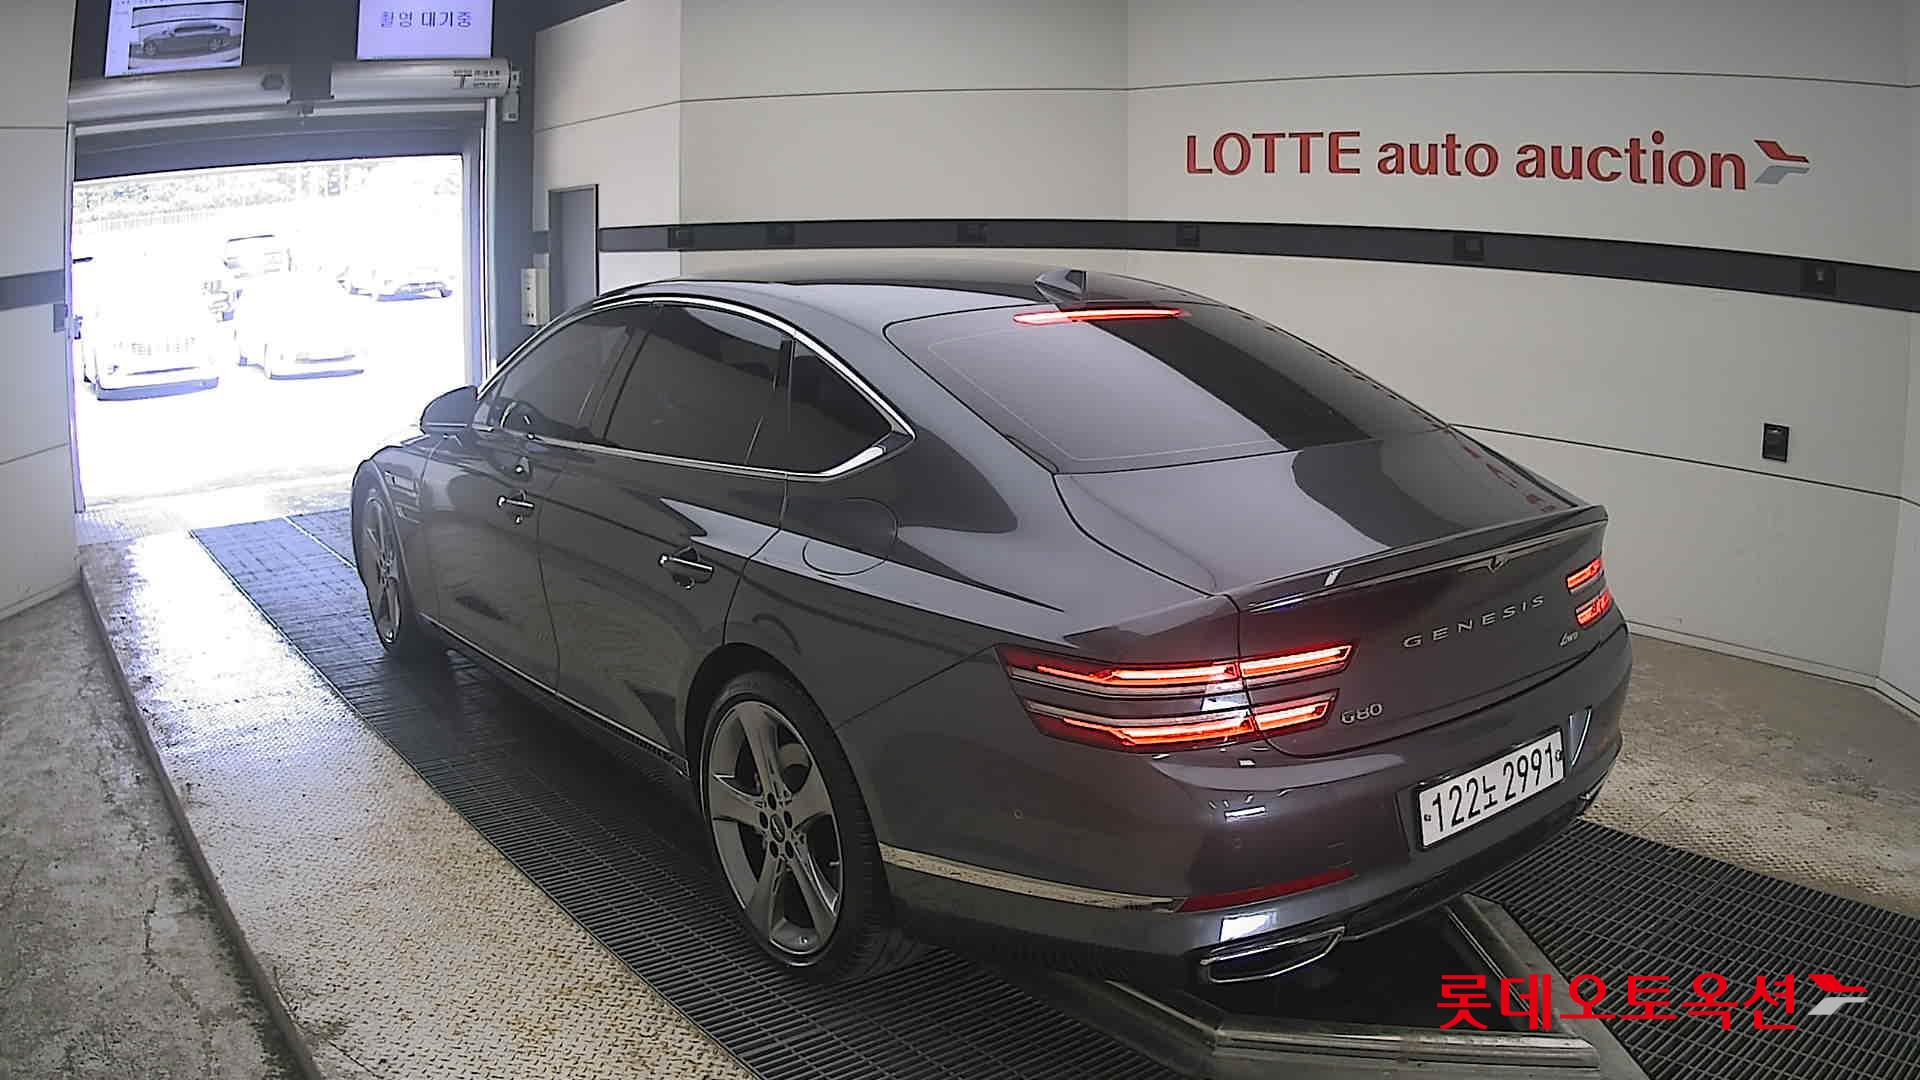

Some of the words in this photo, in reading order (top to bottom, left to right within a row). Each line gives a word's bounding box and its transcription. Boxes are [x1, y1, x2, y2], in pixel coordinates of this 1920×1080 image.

[421, 10, 472, 28] 대기중
[1185, 130, 1360, 176] LOTTE
[1378, 132, 1500, 177] auto
[1516, 130, 1746, 190] auction
[1402, 594, 1545, 649] GENESIS
[1340, 703, 1383, 725] G80
